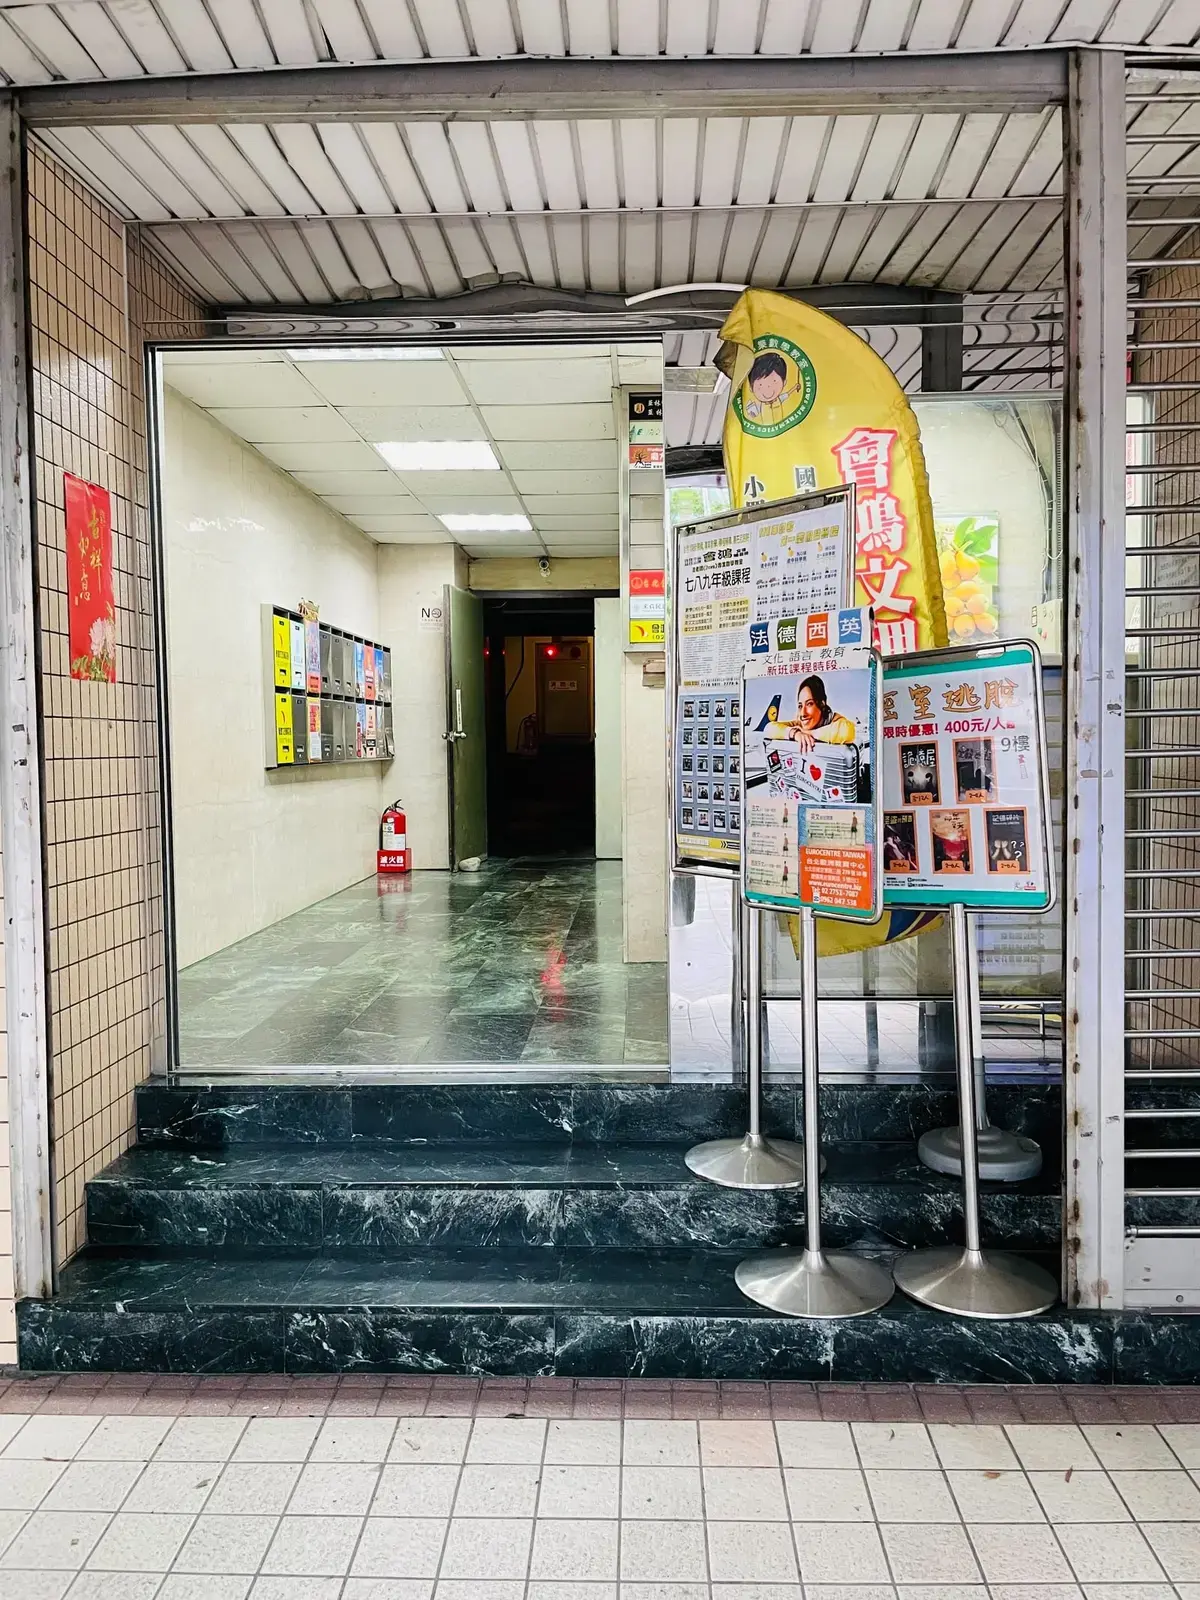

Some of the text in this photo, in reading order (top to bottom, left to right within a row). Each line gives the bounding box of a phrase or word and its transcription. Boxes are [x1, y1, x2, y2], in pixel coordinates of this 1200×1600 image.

[685, 567, 751, 593] 七八九年級課程
[751, 617, 861, 648] 法 德 西 英
[788, 650, 813, 663] 語言
[819, 646, 846, 660] 教育
[944, 716, 1006, 733] 400元/人
[1001, 735, 1031, 752] 9樓
[805, 847, 866, 860] EUROCENTRE TAIWAN
